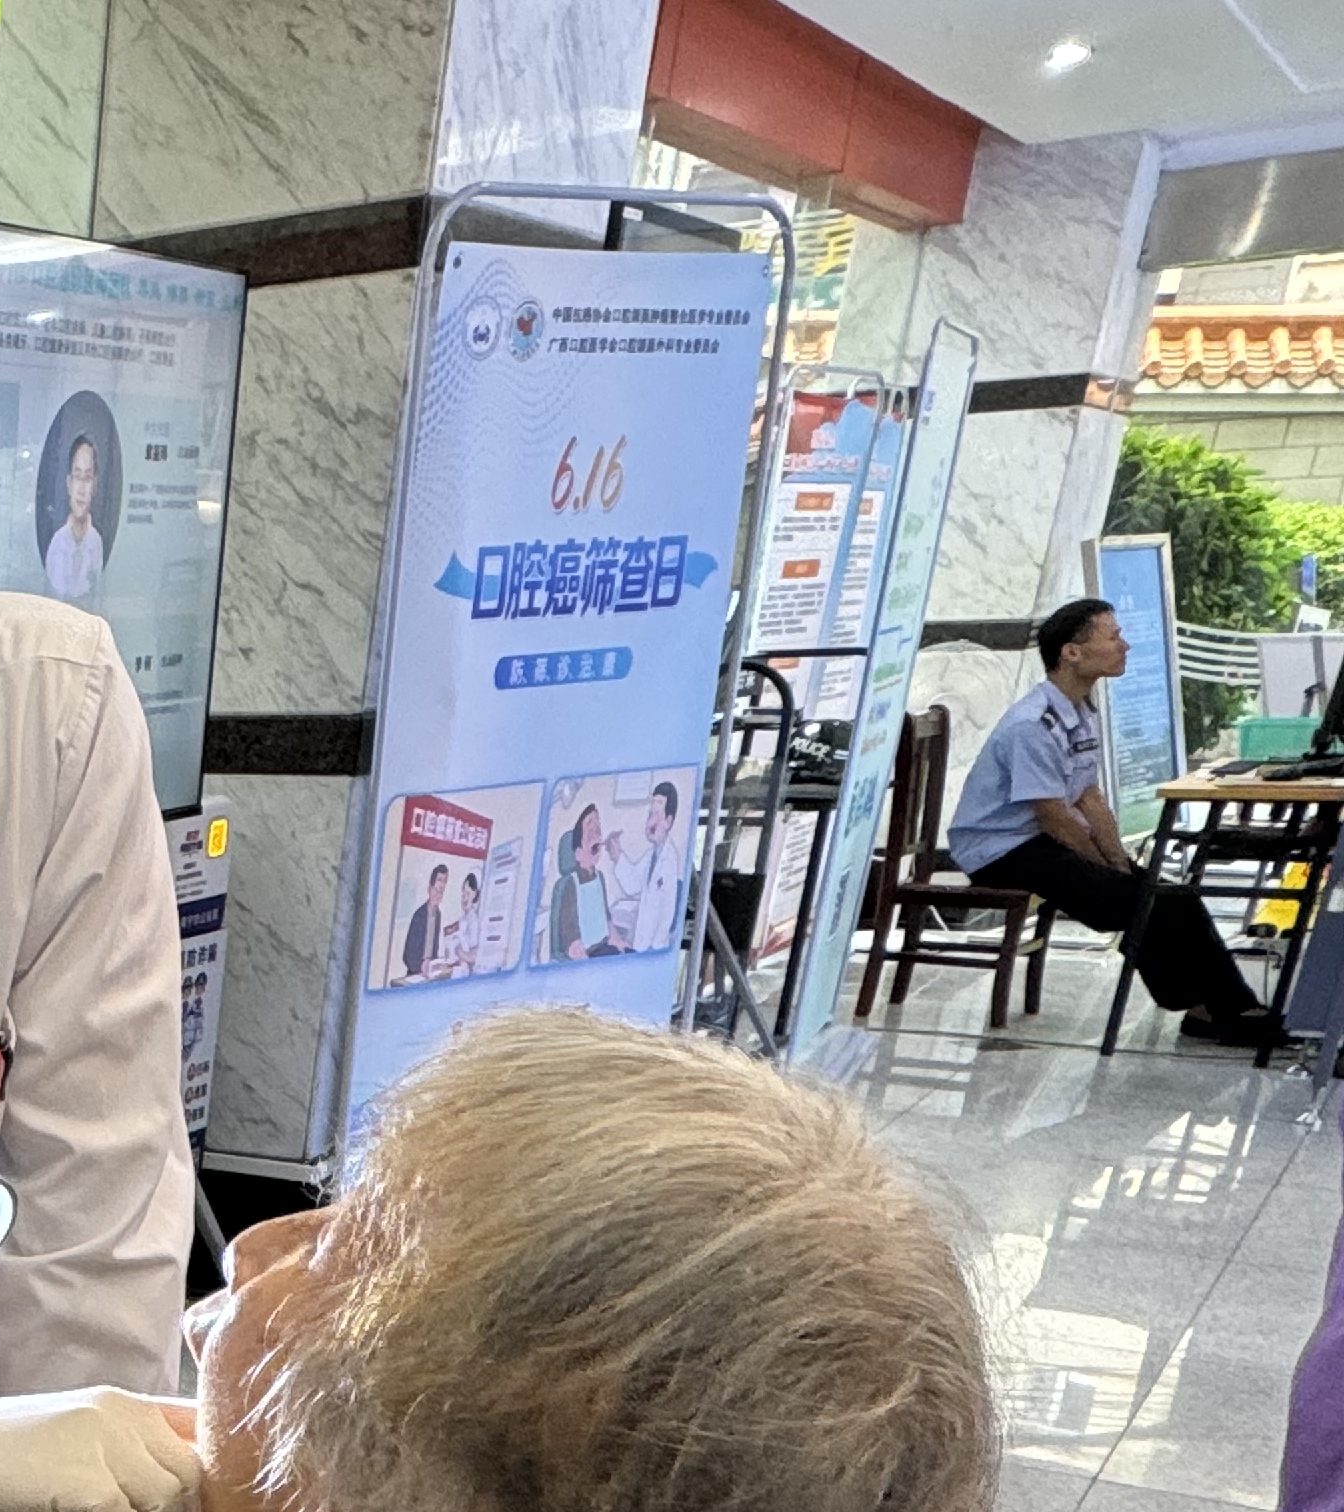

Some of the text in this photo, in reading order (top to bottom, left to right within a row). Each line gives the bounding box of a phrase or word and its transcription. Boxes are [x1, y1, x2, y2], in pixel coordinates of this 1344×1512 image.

[550, 435, 628, 514] 6.16
[471, 534, 689, 621] 口腔癌筛查日
